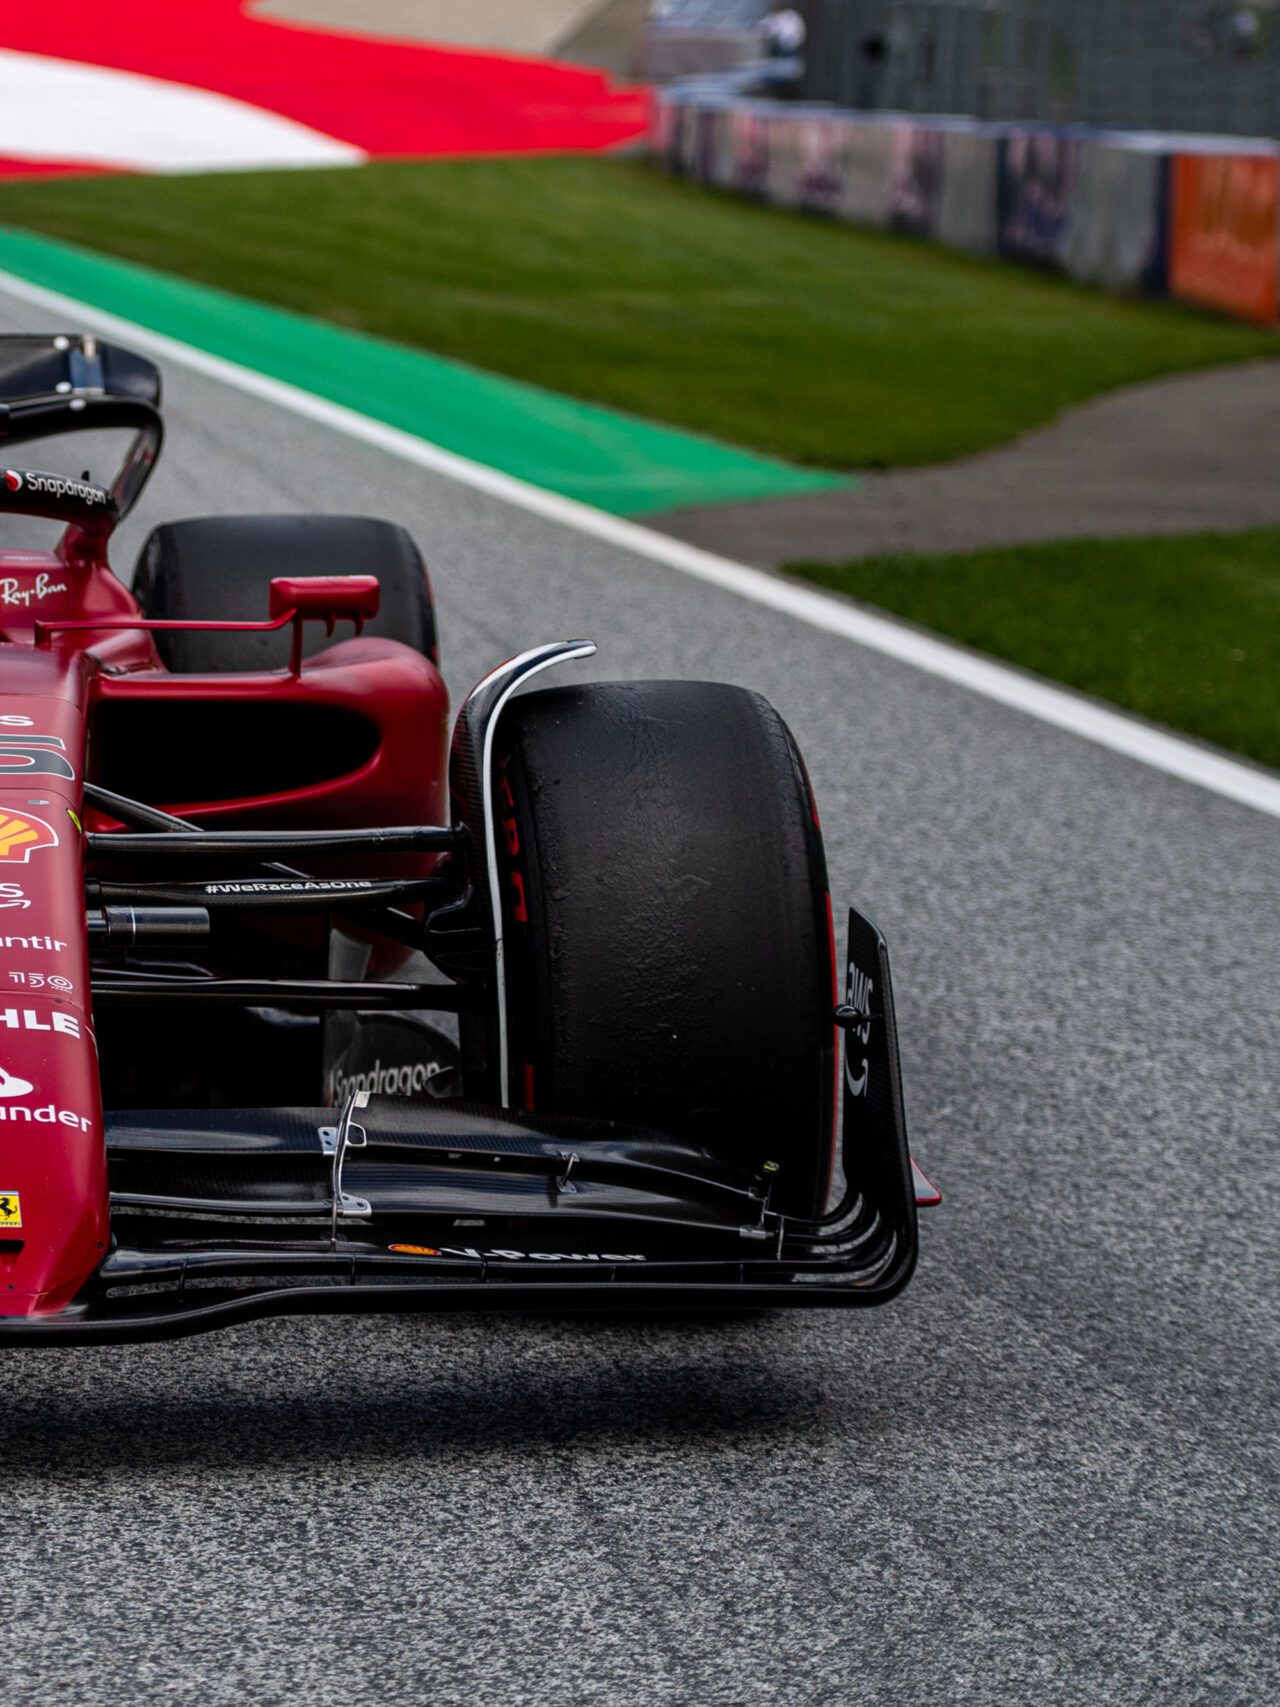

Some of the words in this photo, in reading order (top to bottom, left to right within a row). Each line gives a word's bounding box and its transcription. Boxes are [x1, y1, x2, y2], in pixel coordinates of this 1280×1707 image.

[25, 472, 107, 506] Snapdragon
[205, 880, 373, 895] #WeRaceAsOne
[8, 971, 73, 990] 150
[439, 1246, 648, 1262] V-Power
